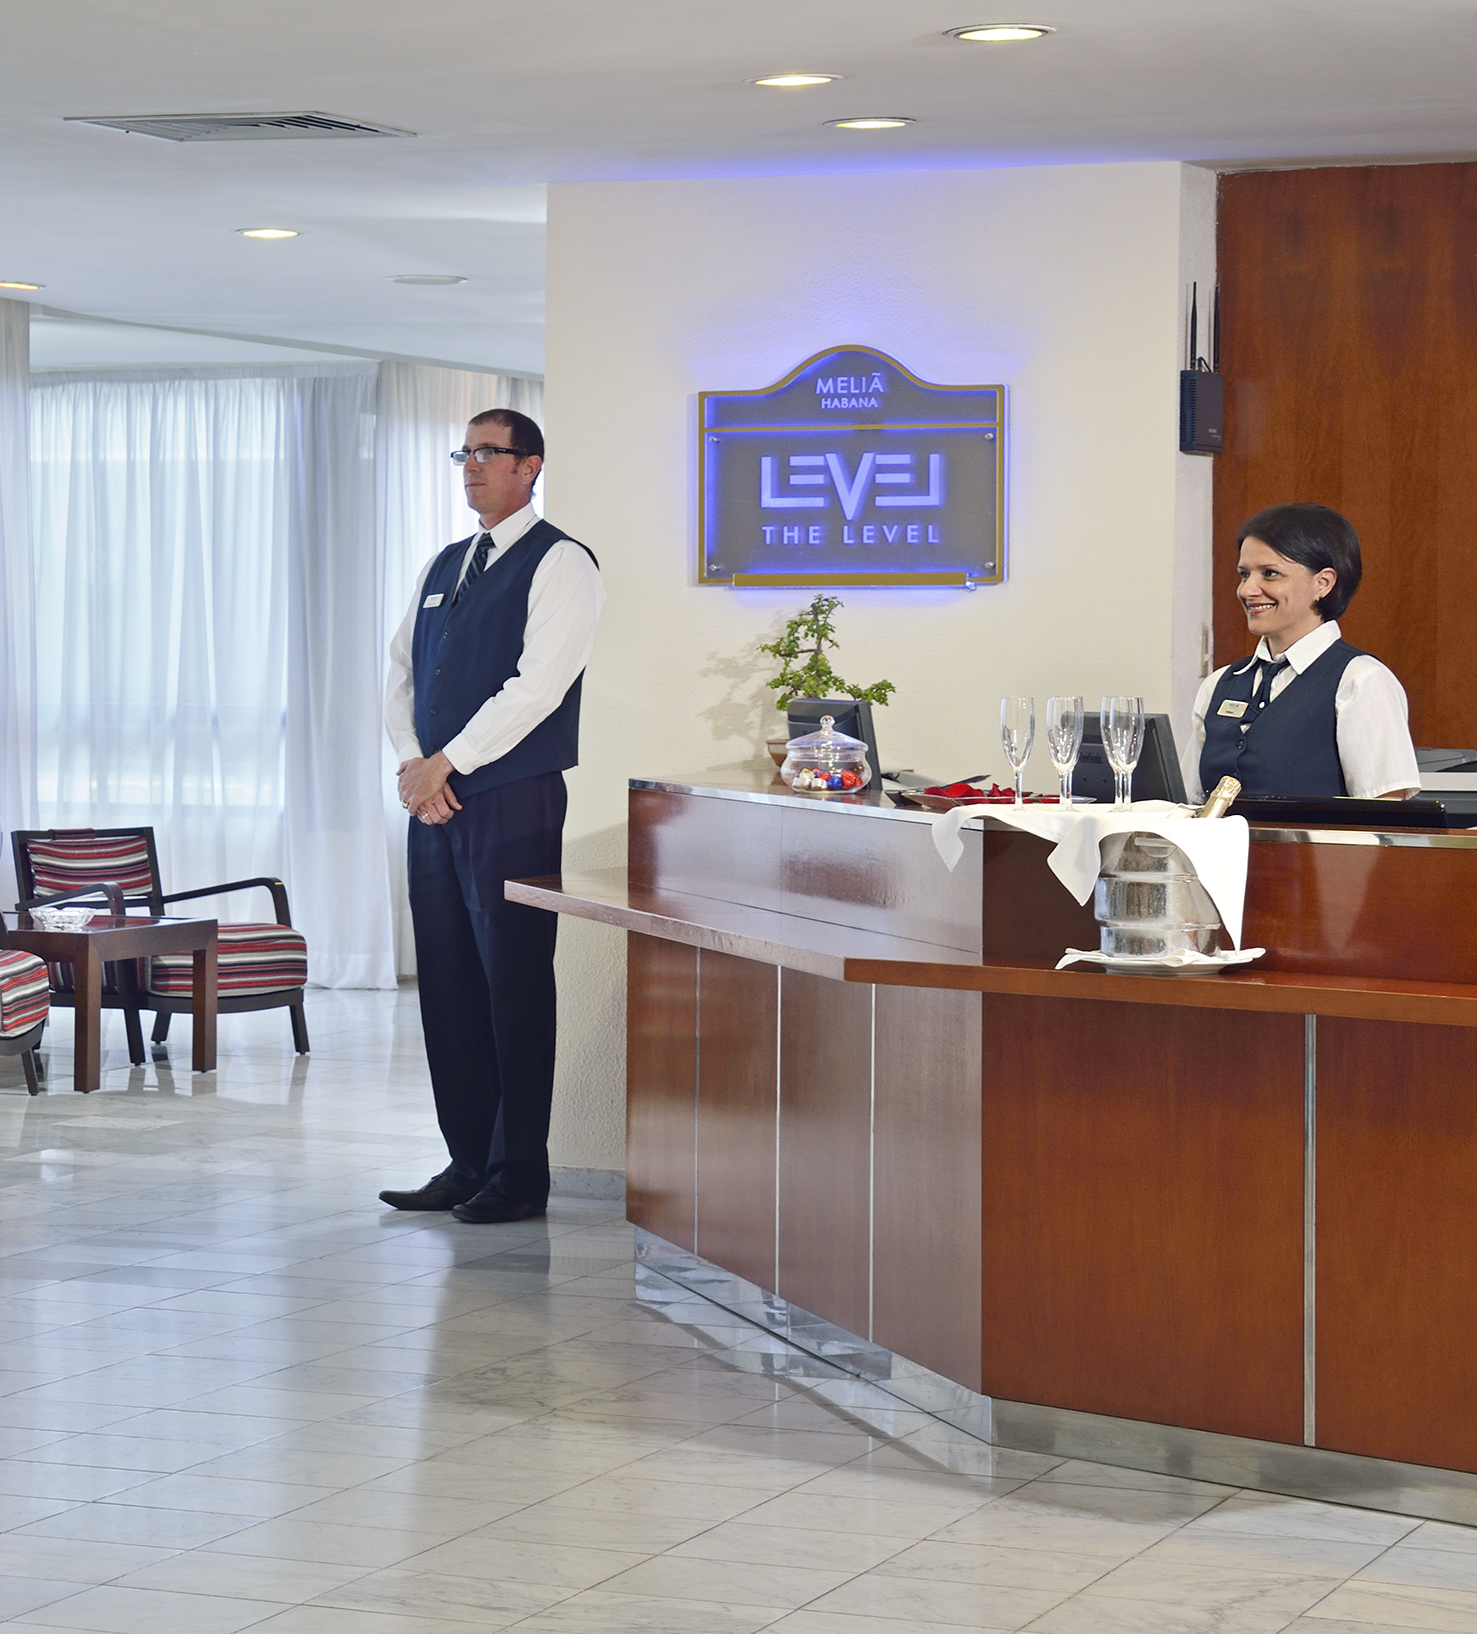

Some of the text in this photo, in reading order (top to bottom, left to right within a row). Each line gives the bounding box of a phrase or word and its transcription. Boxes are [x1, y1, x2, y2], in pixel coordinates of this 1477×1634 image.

[821, 397, 878, 409] HABANA
[761, 452, 940, 520] LEVEL
[761, 524, 940, 545] THE LEVEL
